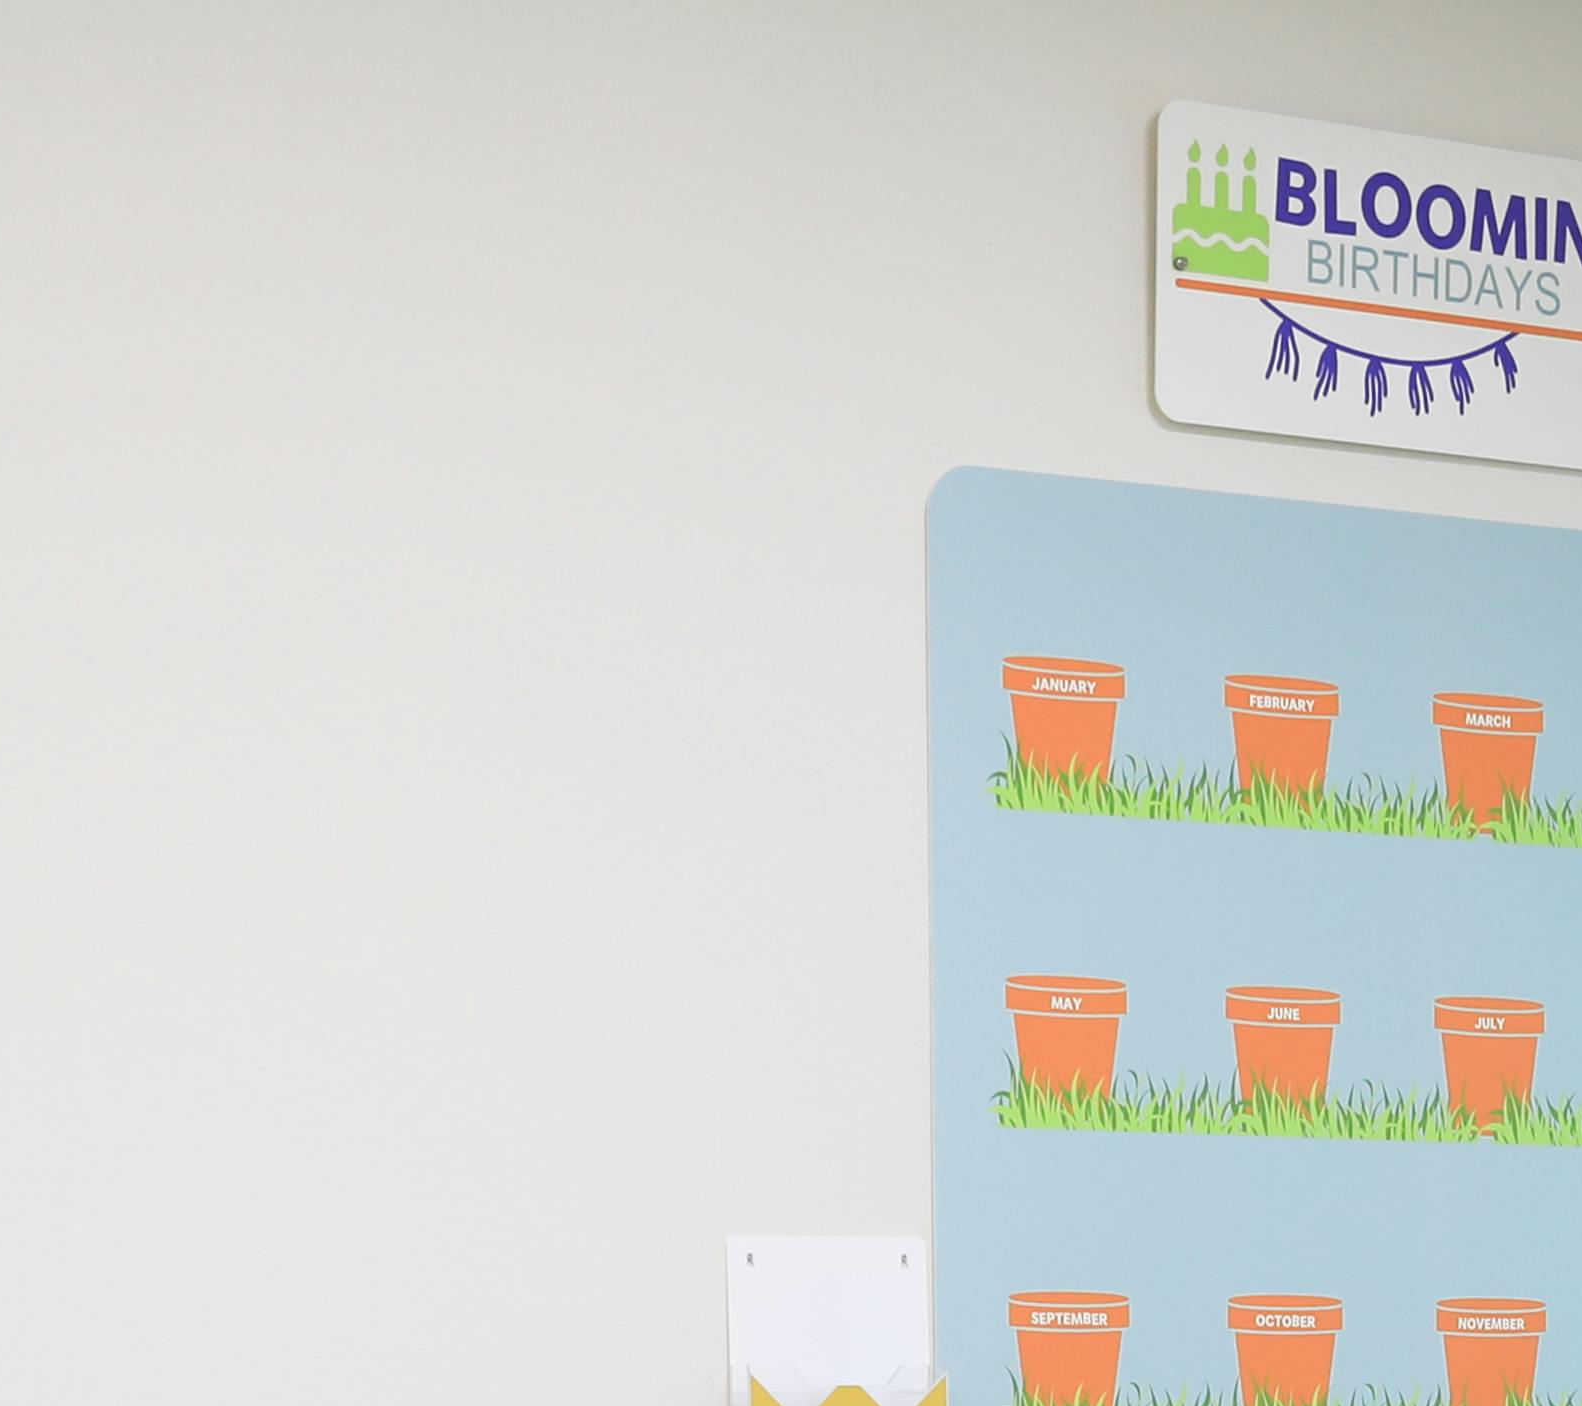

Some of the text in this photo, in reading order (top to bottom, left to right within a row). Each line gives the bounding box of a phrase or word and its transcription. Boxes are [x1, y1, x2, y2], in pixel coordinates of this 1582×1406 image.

[1307, 239, 1562, 316] BIRTHDAYS
[1032, 676, 1096, 695] JANUARY
[1249, 694, 1315, 712] FEBRUARY
[1465, 712, 1511, 728] MARCH
[1051, 996, 1082, 1011] MAY
[1267, 1007, 1301, 1021] JUNE
[1474, 1017, 1506, 1030] JULY
[1030, 1311, 1108, 1326] SEPTEMBER
[1255, 1314, 1316, 1328] OCTOBER
[1457, 1316, 1525, 1330] NOVEMBER
